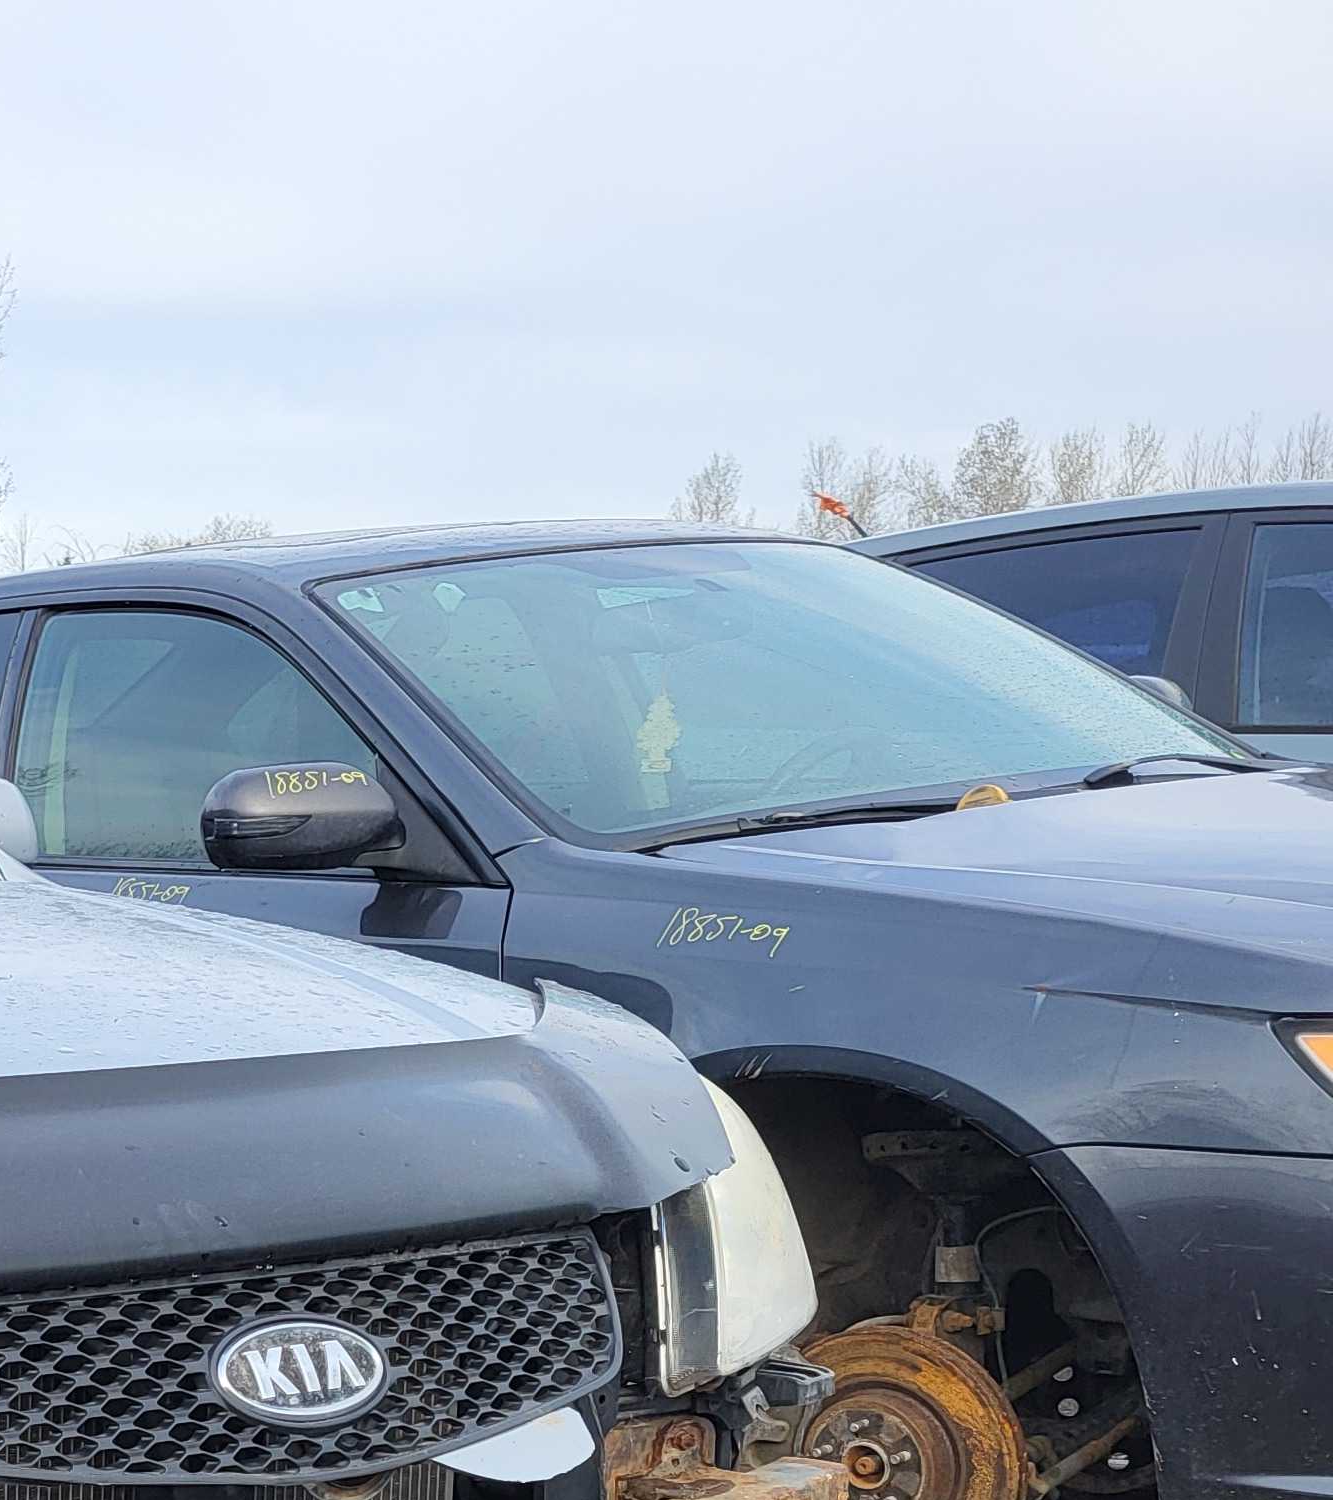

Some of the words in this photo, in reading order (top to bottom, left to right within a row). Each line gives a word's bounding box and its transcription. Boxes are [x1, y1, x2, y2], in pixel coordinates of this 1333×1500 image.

[264, 769, 369, 800] 18851-09
[655, 906, 790, 959] 18851-09
[242, 1339, 366, 1400] KIA
